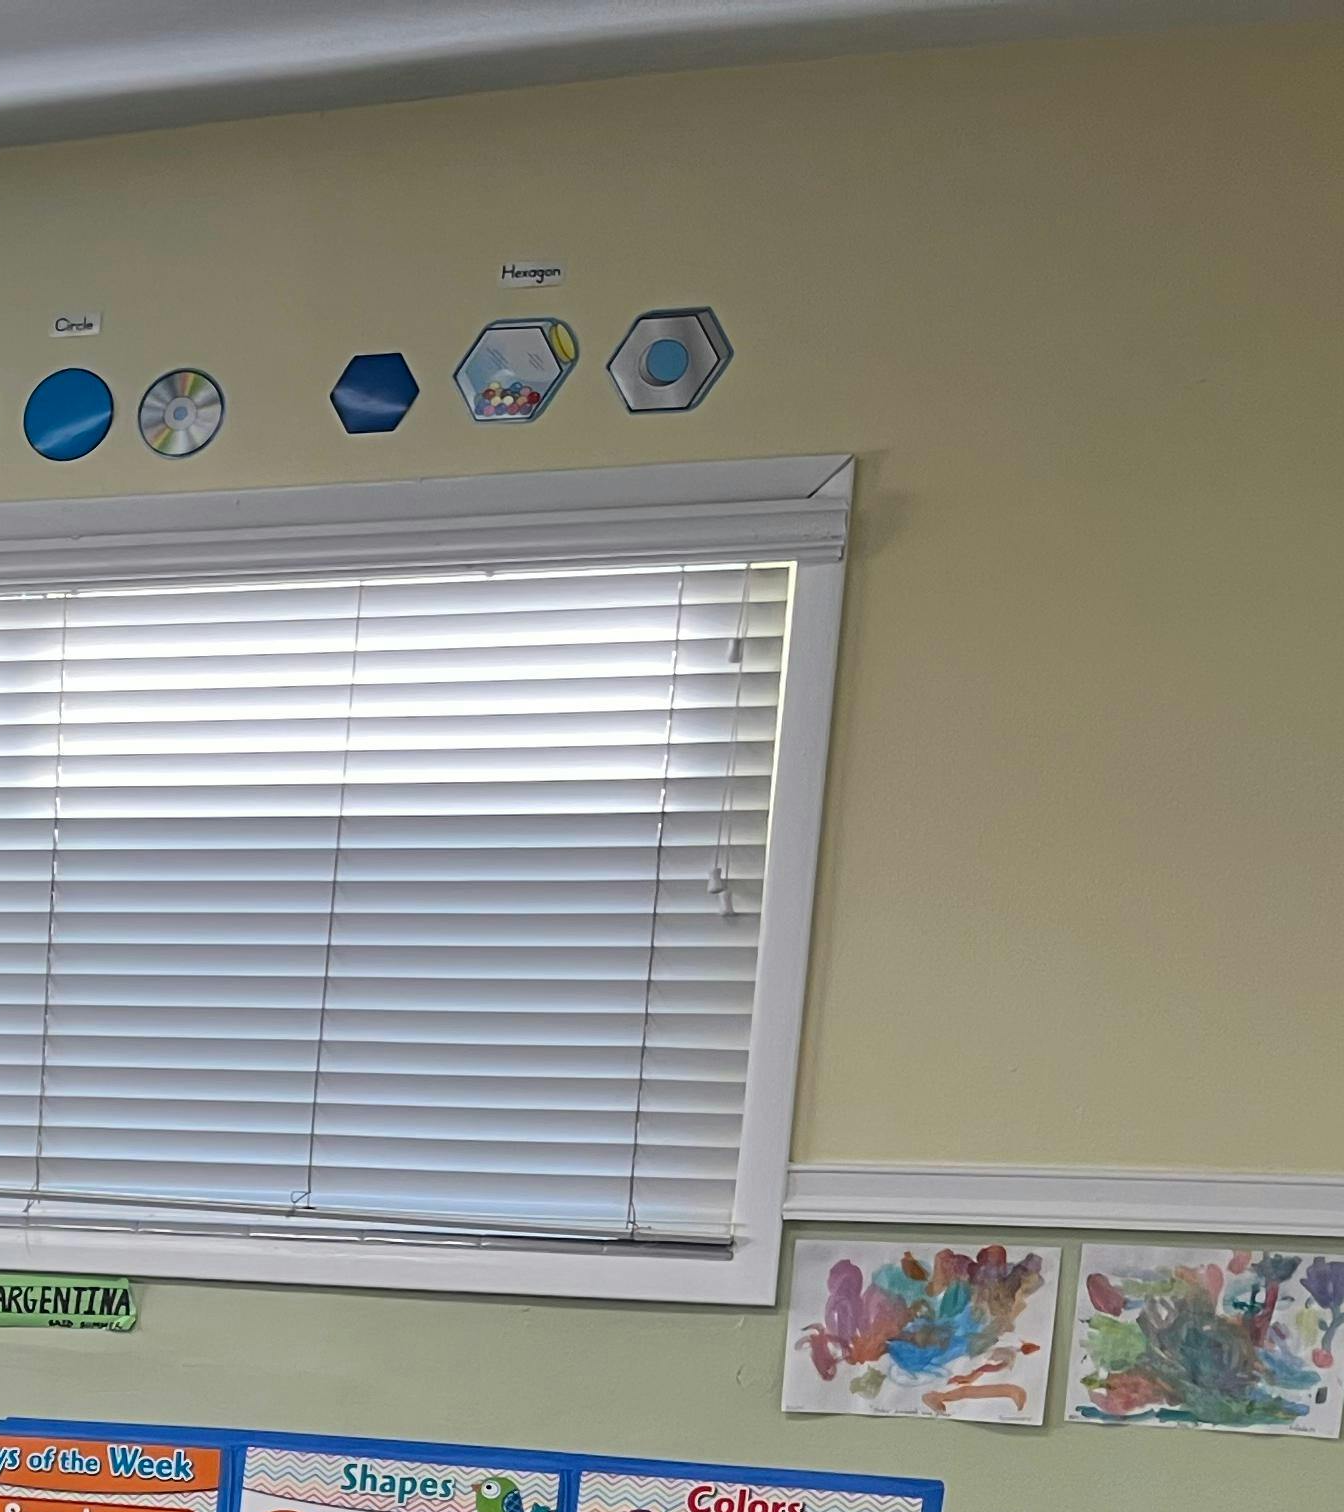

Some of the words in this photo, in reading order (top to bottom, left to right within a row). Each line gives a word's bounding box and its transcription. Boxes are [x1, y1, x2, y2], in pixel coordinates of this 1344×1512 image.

[501, 263, 561, 282] Hexagon
[54, 316, 94, 334] Circle
[27, 1447, 56, 1473] of
[58, 1449, 101, 1476] the
[107, 1444, 194, 1481] Week
[340, 1462, 456, 1504] Shapes
